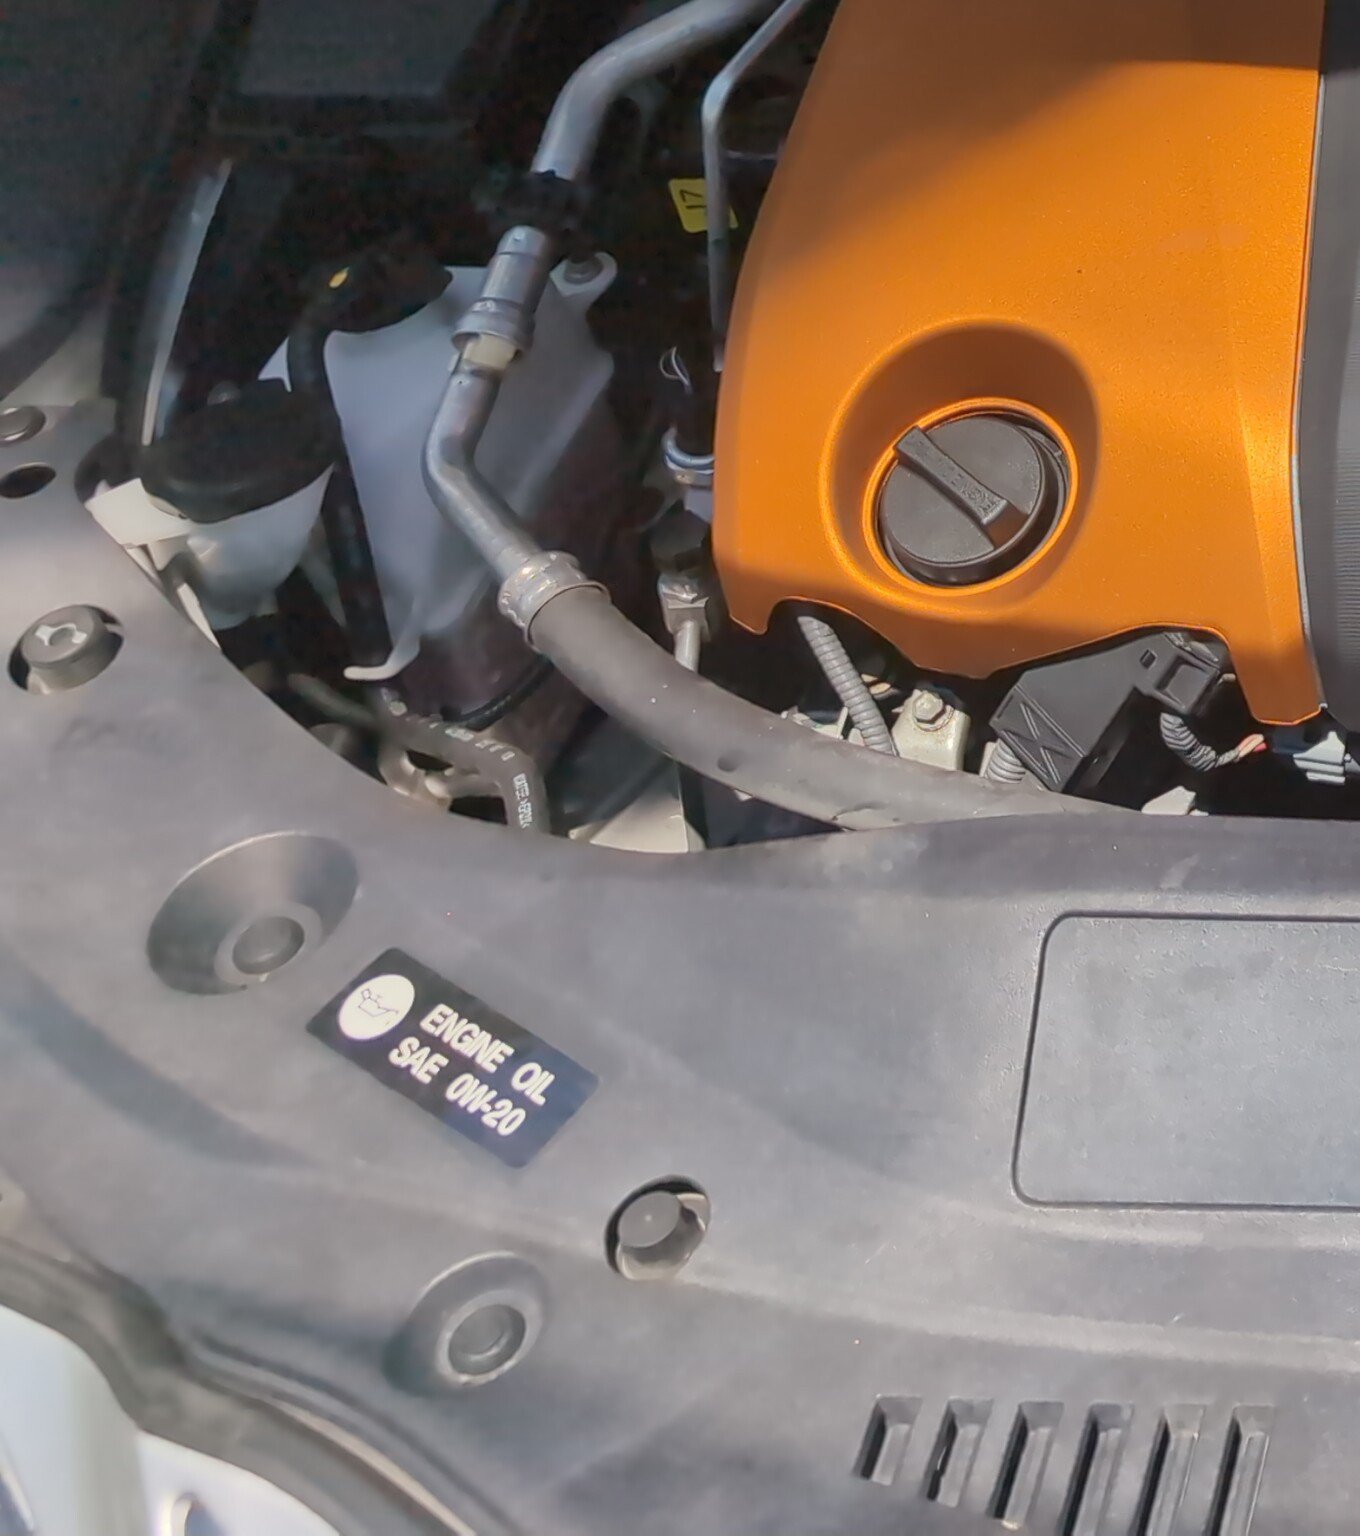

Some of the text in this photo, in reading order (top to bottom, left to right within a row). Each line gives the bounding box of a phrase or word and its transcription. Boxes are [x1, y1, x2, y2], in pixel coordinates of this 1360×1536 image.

[388, 1036, 526, 1136] SAE 0W-20
[419, 1003, 555, 1106] ENGINE OIL
